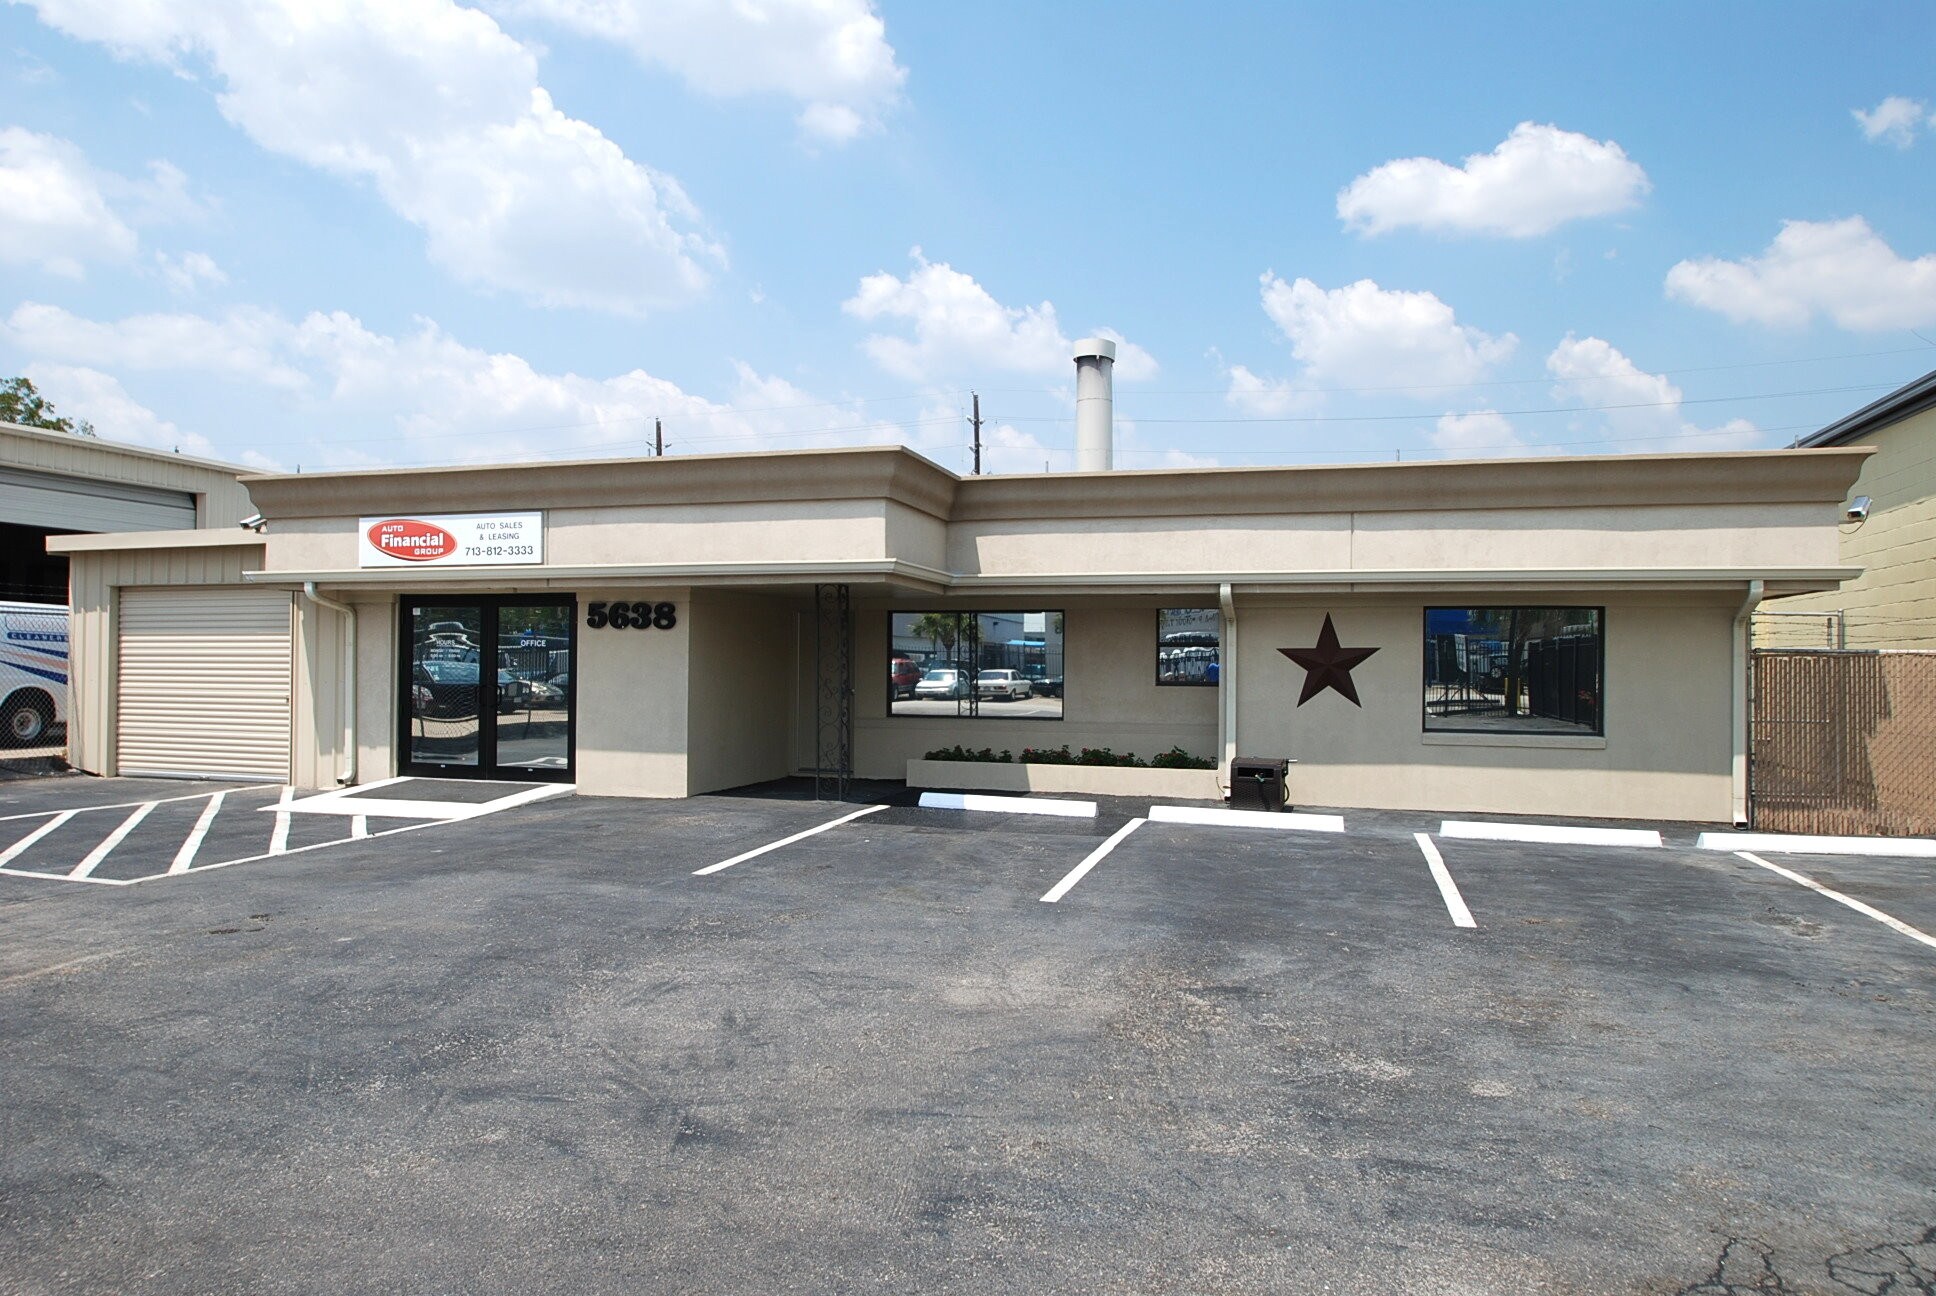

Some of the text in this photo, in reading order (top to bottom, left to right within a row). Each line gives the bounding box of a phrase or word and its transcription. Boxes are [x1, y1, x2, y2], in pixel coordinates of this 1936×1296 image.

[476, 522, 496, 530] AUTO
[381, 533, 444, 548] Financial
[465, 545, 534, 556] 713-812-3333
[586, 602, 676, 630] 5638
[436, 639, 456, 647] HOURS
[520, 639, 547, 647] OFFICE
